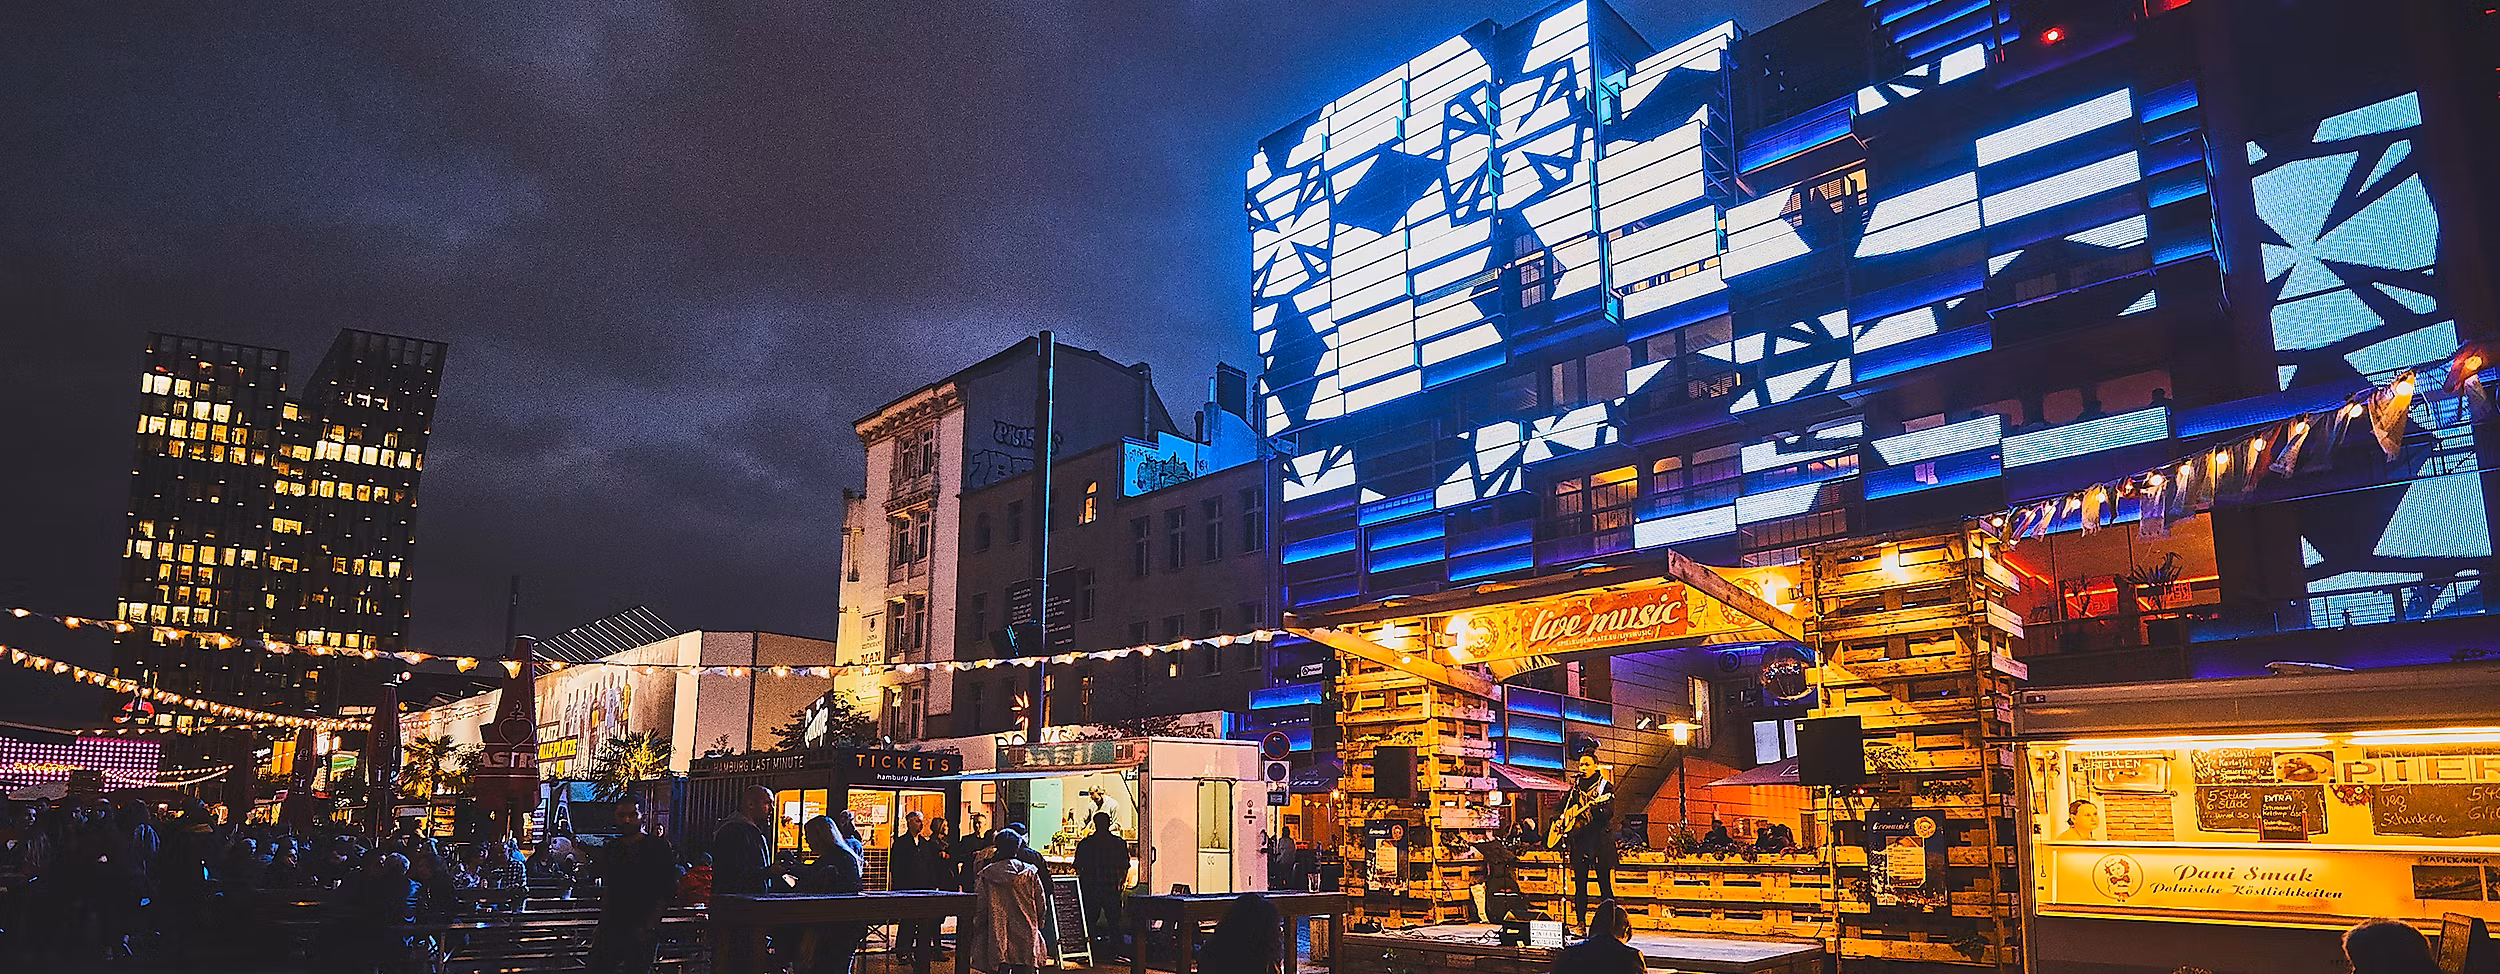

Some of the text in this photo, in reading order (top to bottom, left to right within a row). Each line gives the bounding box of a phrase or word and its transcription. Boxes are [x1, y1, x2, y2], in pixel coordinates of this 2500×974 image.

[1529, 593, 1682, 642] live music
[479, 751, 537, 768] ASTR
[713, 755, 805, 773] HAMBURG LAST MINUTE
[856, 754, 950, 771] TICKETS
[2077, 759, 2142, 773] BESTELLEN
[877, 773, 909, 783] hamburg
[2263, 794, 2293, 803] EXTRA
[2173, 864, 2313, 882] Pani Smak
[2149, 882, 2343, 899] Polnische Köstlichkeiten
